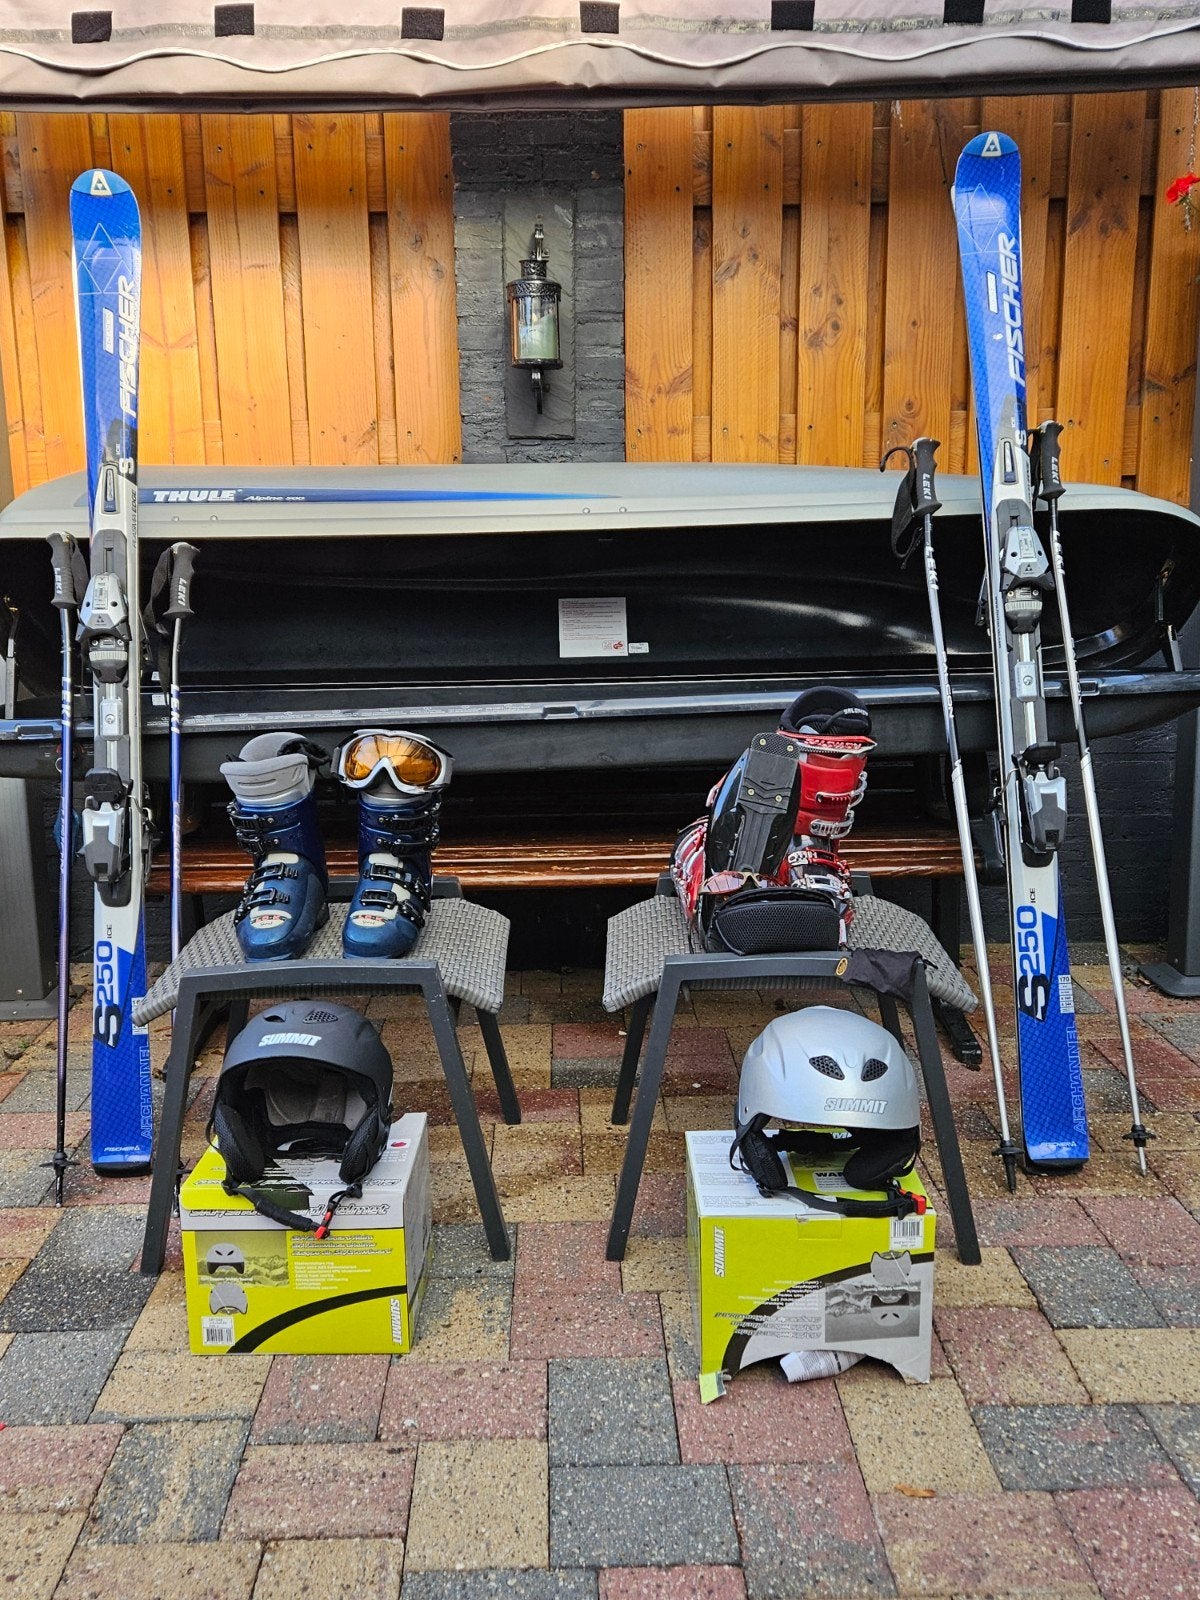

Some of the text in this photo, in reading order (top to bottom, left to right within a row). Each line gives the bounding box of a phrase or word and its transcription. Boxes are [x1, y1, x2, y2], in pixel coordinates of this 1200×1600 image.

[997, 232, 1027, 389] FISCHER
[118, 274, 138, 418] FISCHER
[1051, 456, 1060, 484] LEKI
[153, 489, 238, 502] THULE
[243, 495, 284, 503] Alpine
[922, 473, 932, 500] LEKI
[53, 567, 63, 595] LEKI
[177, 577, 188, 607] LEKI
[1029, 887, 1037, 904] ICE
[1017, 905, 1050, 1021] S250
[94, 940, 122, 1048] S250
[258, 1032, 322, 1047] SUMMIT
[1066, 1020, 1086, 1135] AIRCHANNEL
[824, 1097, 888, 1115] SUMMIT
[335, 1202, 391, 1216] elmet
[713, 1225, 726, 1278] SUMMIT
[390, 1297, 402, 1346] SUMMIT
